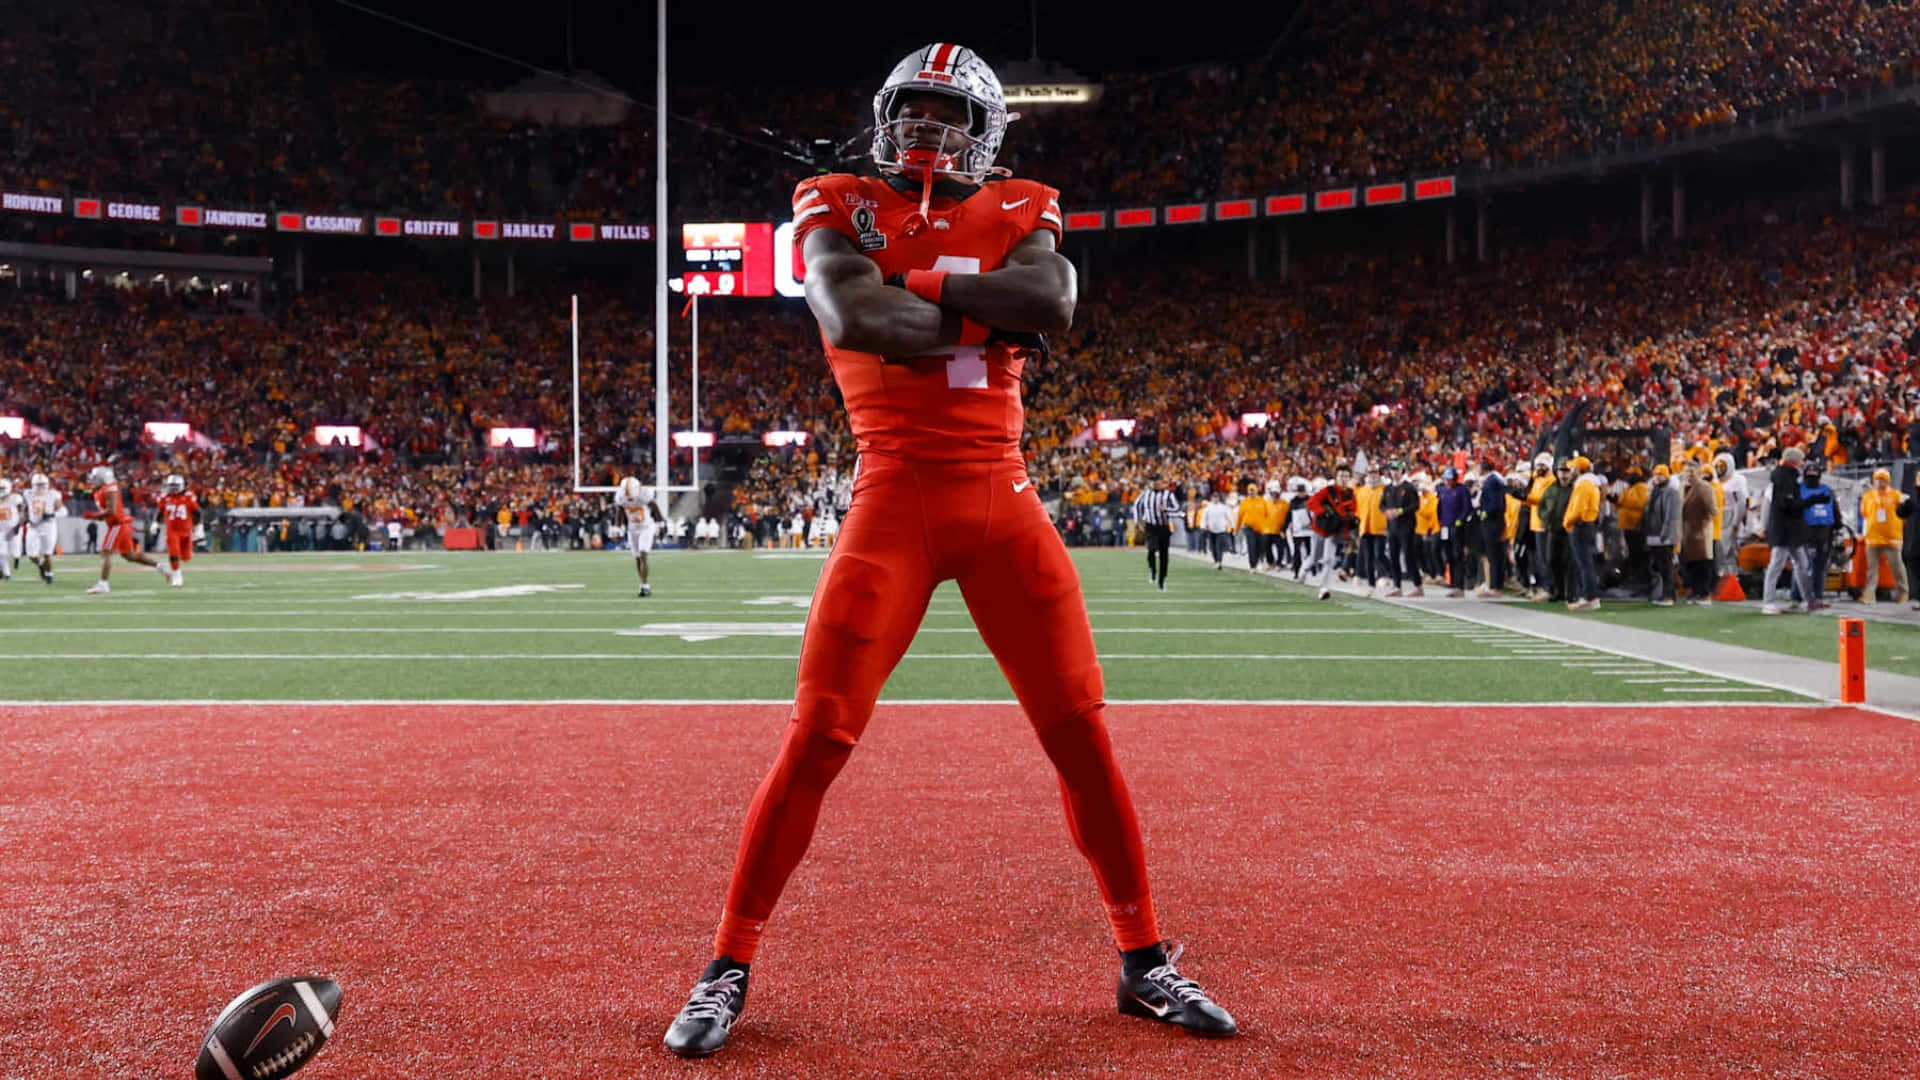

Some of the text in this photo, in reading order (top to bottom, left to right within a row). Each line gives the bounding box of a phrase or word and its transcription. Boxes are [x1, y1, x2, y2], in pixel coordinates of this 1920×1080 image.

[2, 194, 62, 213] HORVATH
[107, 203, 161, 221] GEORGE
[205, 210, 266, 228] JANOWICZ
[305, 216, 363, 232] CASSADY
[404, 221, 459, 236] GRIFFIN
[503, 224, 555, 238] HARLEY
[601, 226, 650, 240] WILLIS
[166, 504, 187, 520] 74
